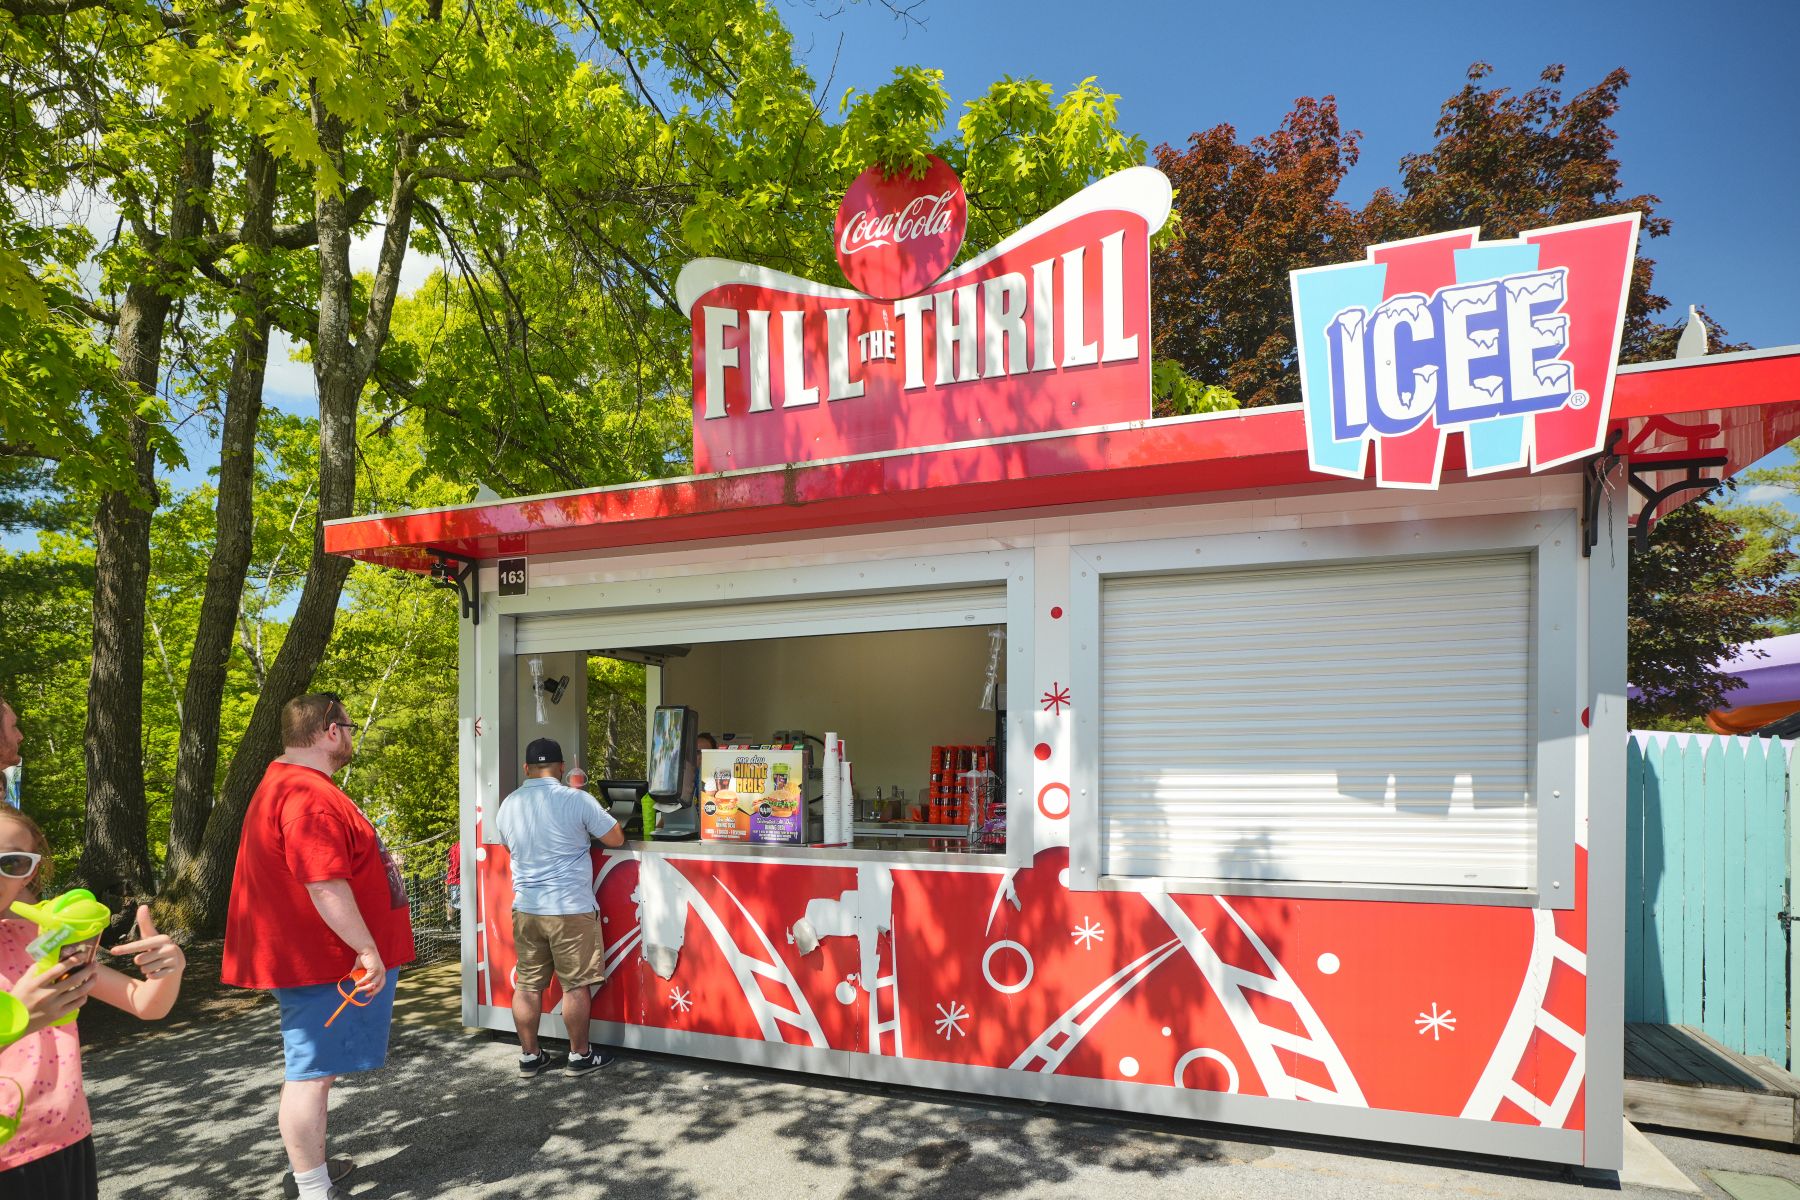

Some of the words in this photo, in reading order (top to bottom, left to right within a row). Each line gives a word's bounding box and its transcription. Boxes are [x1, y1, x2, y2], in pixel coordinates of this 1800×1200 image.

[840, 188, 959, 255] Coca-Cola
[702, 305, 866, 420] FILL
[857, 329, 897, 365] THE
[894, 229, 1139, 390] THRILL
[1327, 268, 1571, 441] ICEE
[500, 570, 525, 585] 163
[734, 763, 768, 779] DINING
[592, 1055, 602, 1065] N
